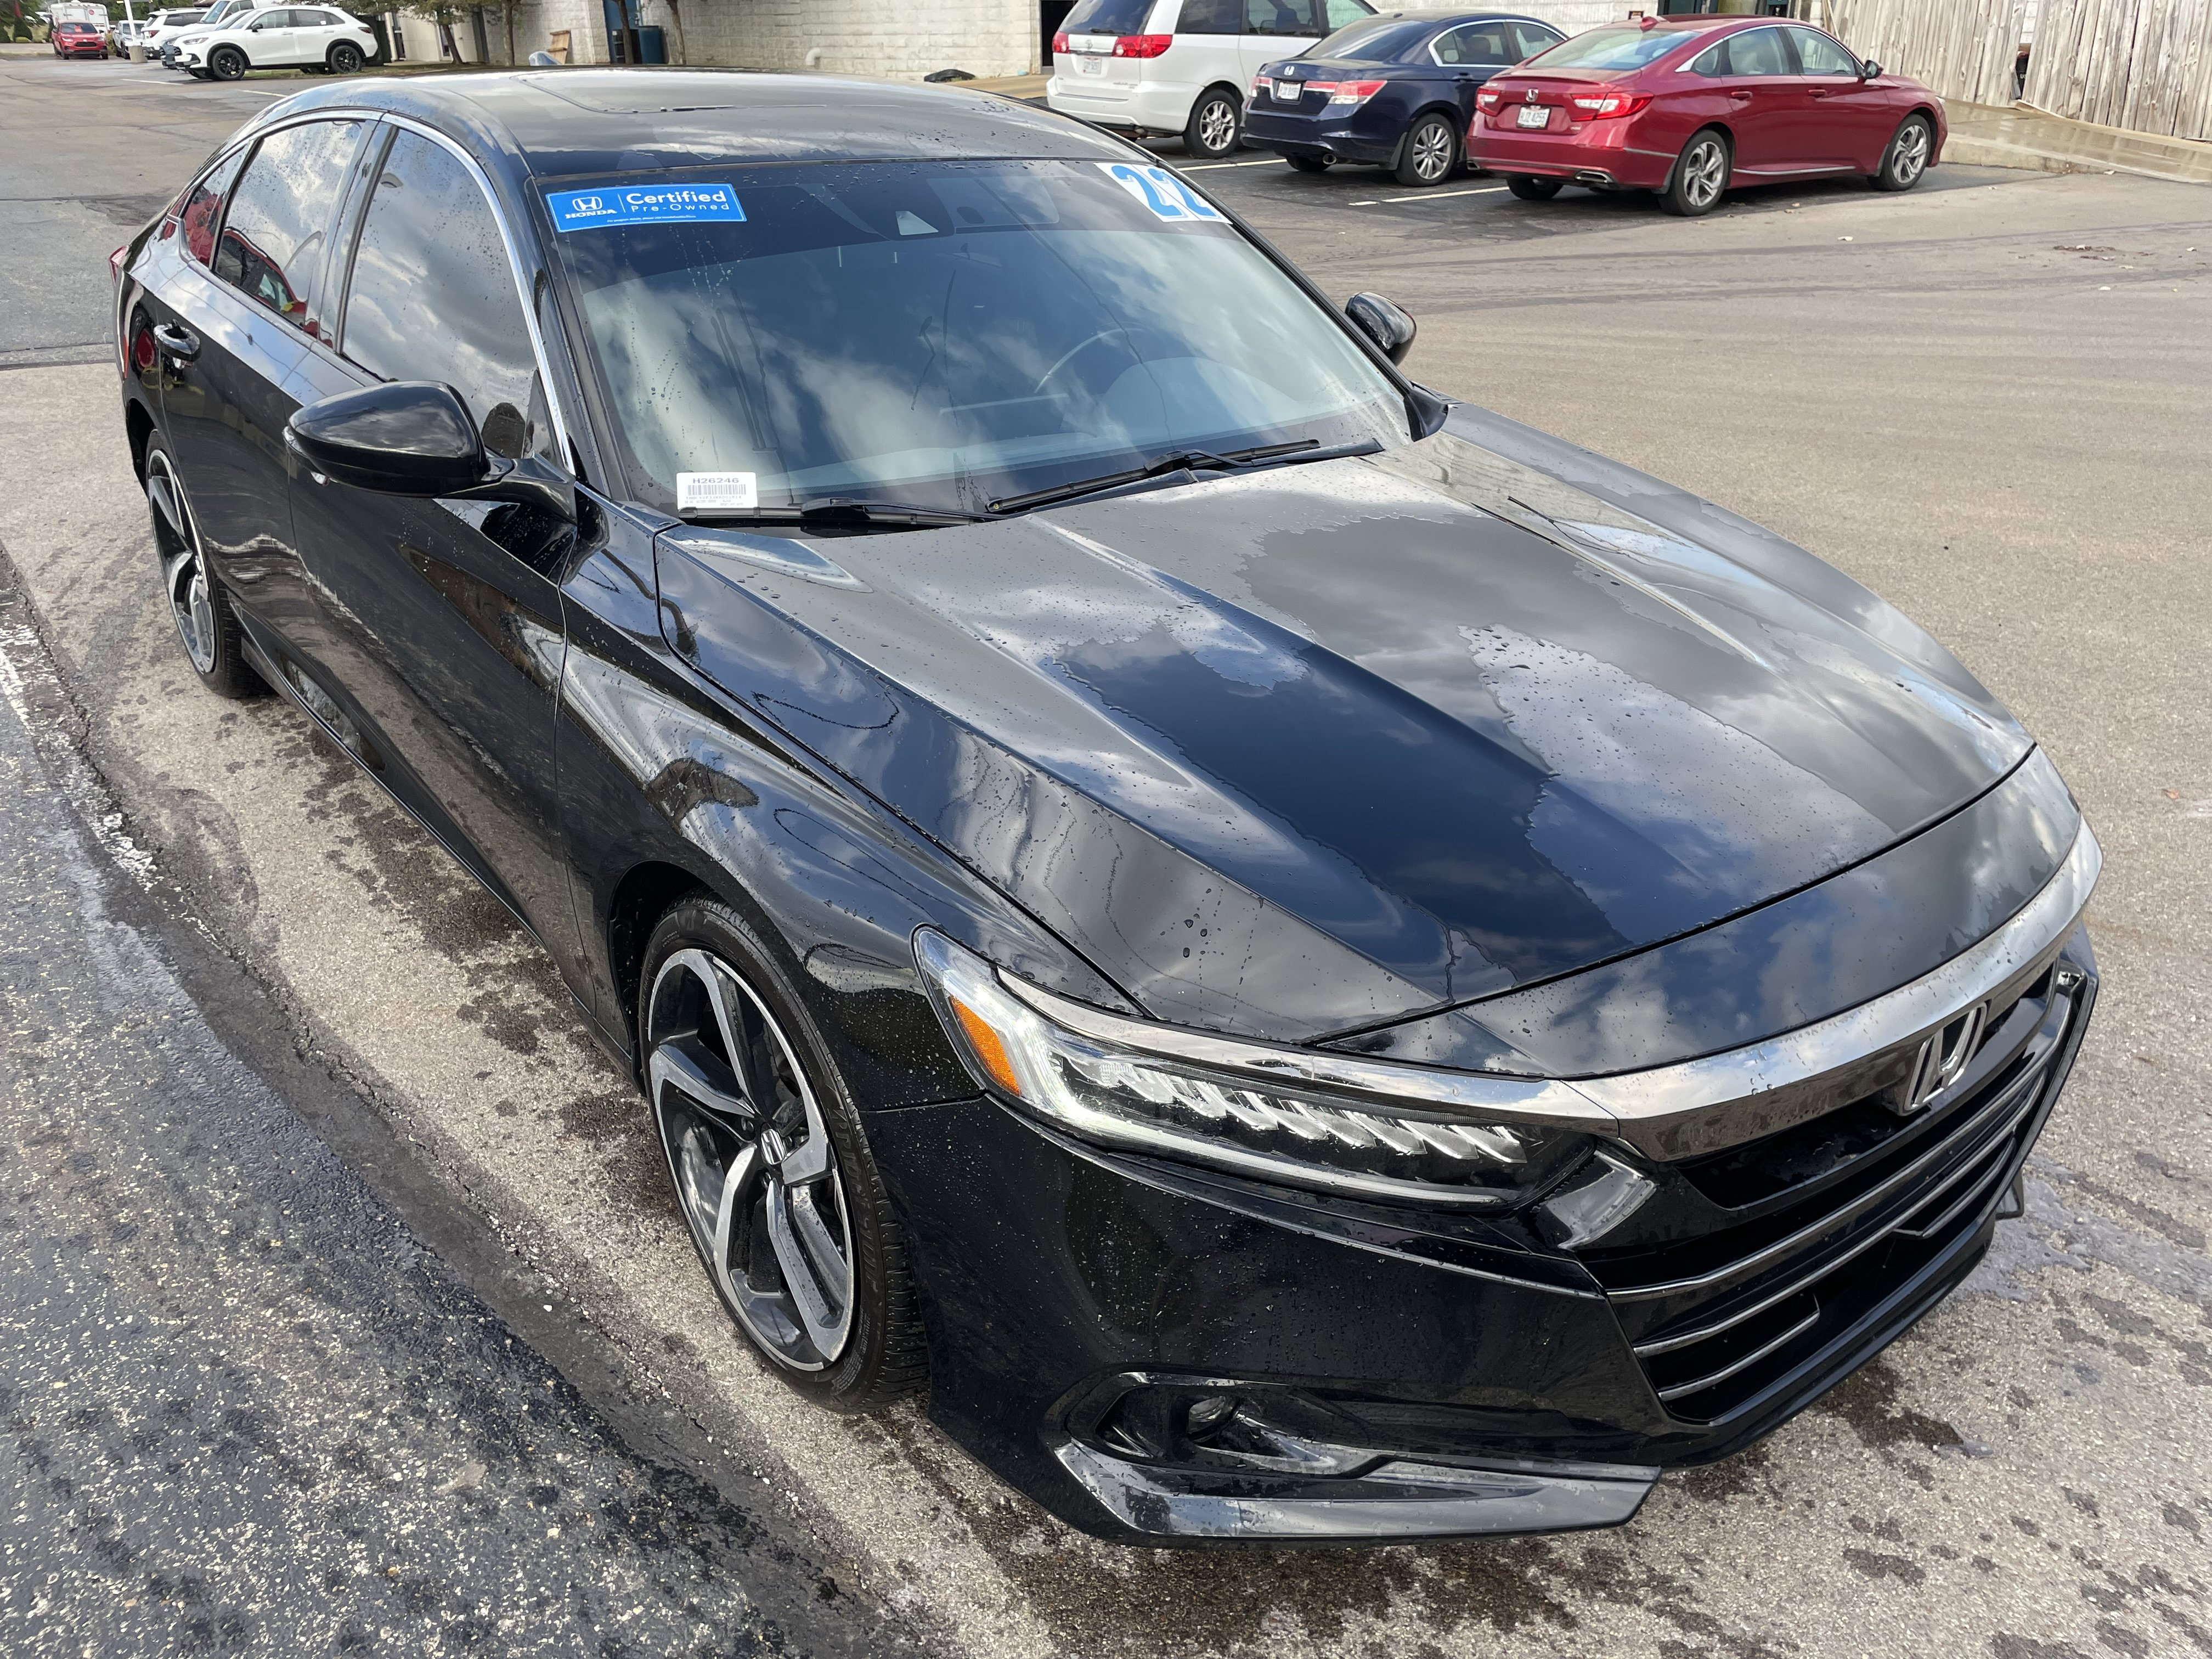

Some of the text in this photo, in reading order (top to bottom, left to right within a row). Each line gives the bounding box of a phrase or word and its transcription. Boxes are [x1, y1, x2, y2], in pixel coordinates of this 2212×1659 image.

[626, 190, 727, 205] Certified
[1111, 165, 1219, 217] 22
[565, 208, 617, 219] HONDA
[631, 203, 730, 212] Pre-Owned
